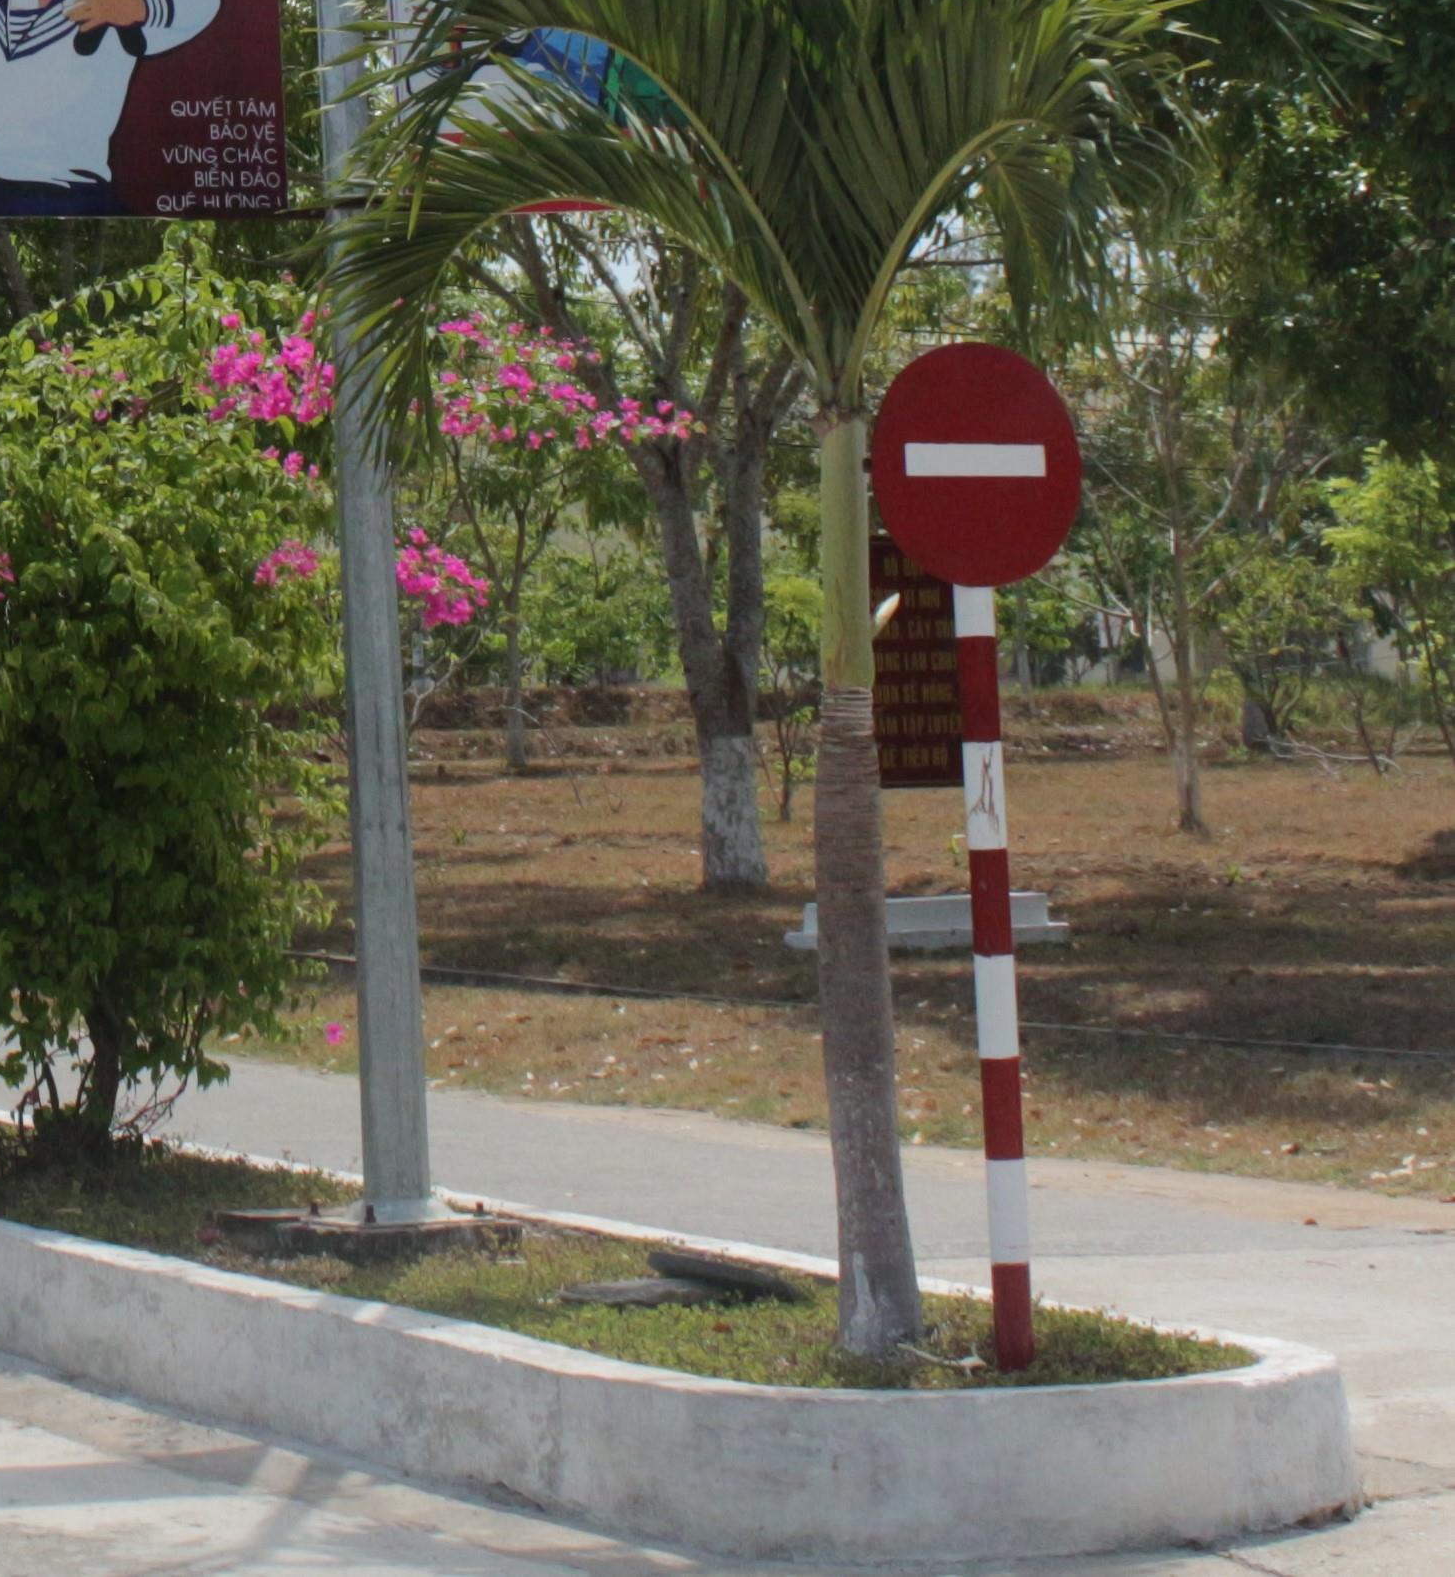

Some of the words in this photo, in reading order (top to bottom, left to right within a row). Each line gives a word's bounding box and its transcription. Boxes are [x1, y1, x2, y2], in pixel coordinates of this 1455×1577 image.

[171, 95, 232, 117] QUYẾT
[237, 97, 276, 117] TÂM
[210, 118, 248, 140] BẢO
[252, 121, 276, 144] VỆ
[161, 144, 218, 164] VỮNG
[222, 141, 278, 164] CHẮC
[194, 163, 235, 188] BIỂN
[240, 165, 281, 188] ĐẢO
